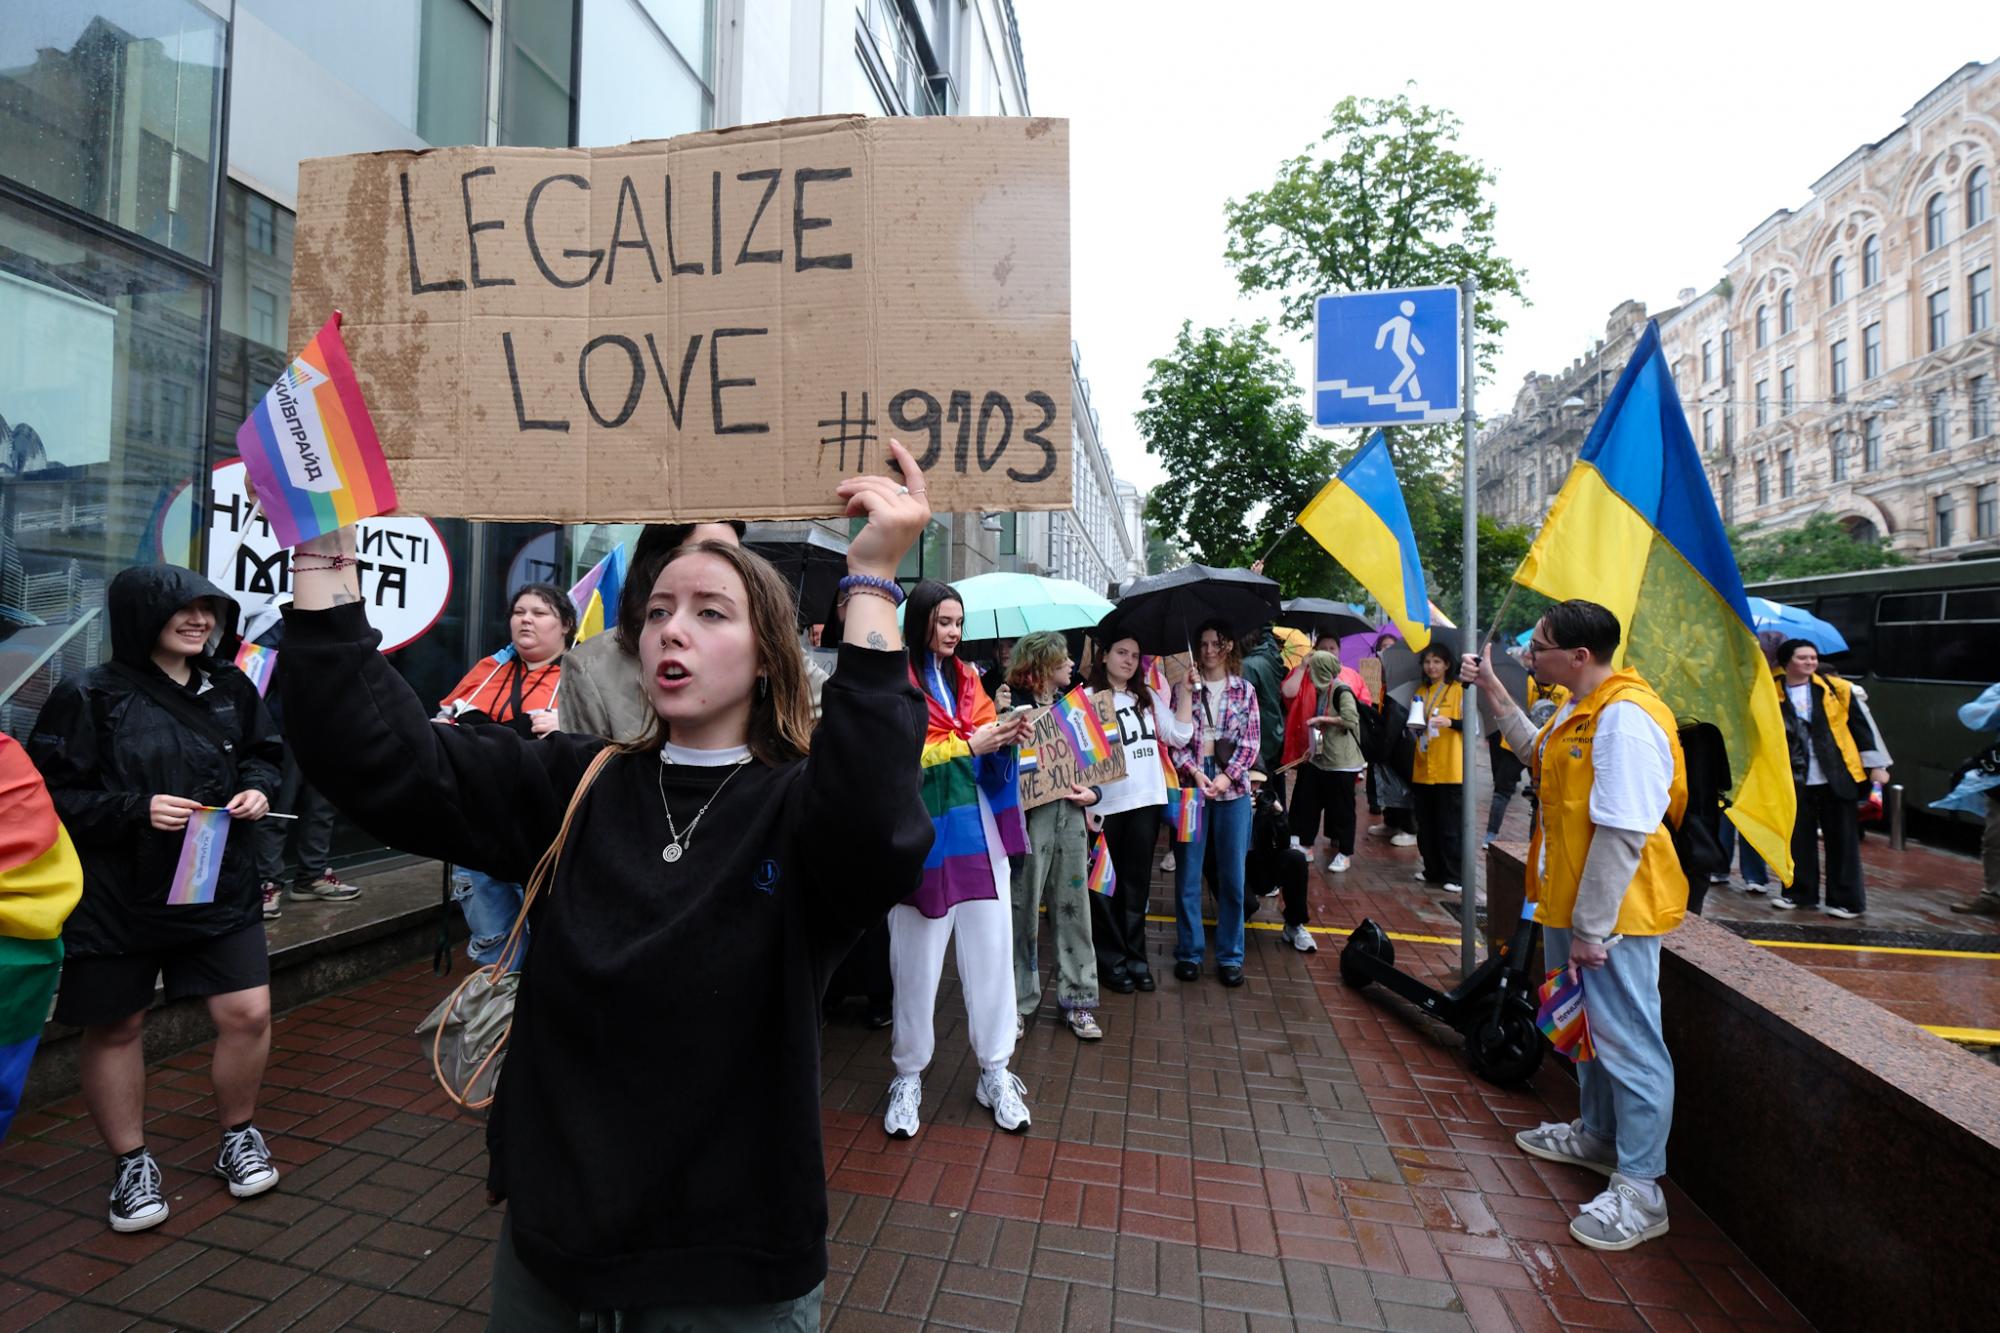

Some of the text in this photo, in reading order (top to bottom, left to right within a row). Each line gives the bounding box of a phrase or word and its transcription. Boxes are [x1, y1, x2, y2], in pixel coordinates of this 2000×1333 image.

[400, 166, 853, 295] LEGALIZE
[274, 378, 323, 482] КИЇВПРАЙД
[502, 328, 769, 435] LOVE
[818, 388, 1058, 483] #9103
[1048, 763, 1071, 792] YOU
[1132, 746, 1154, 759] 1919
